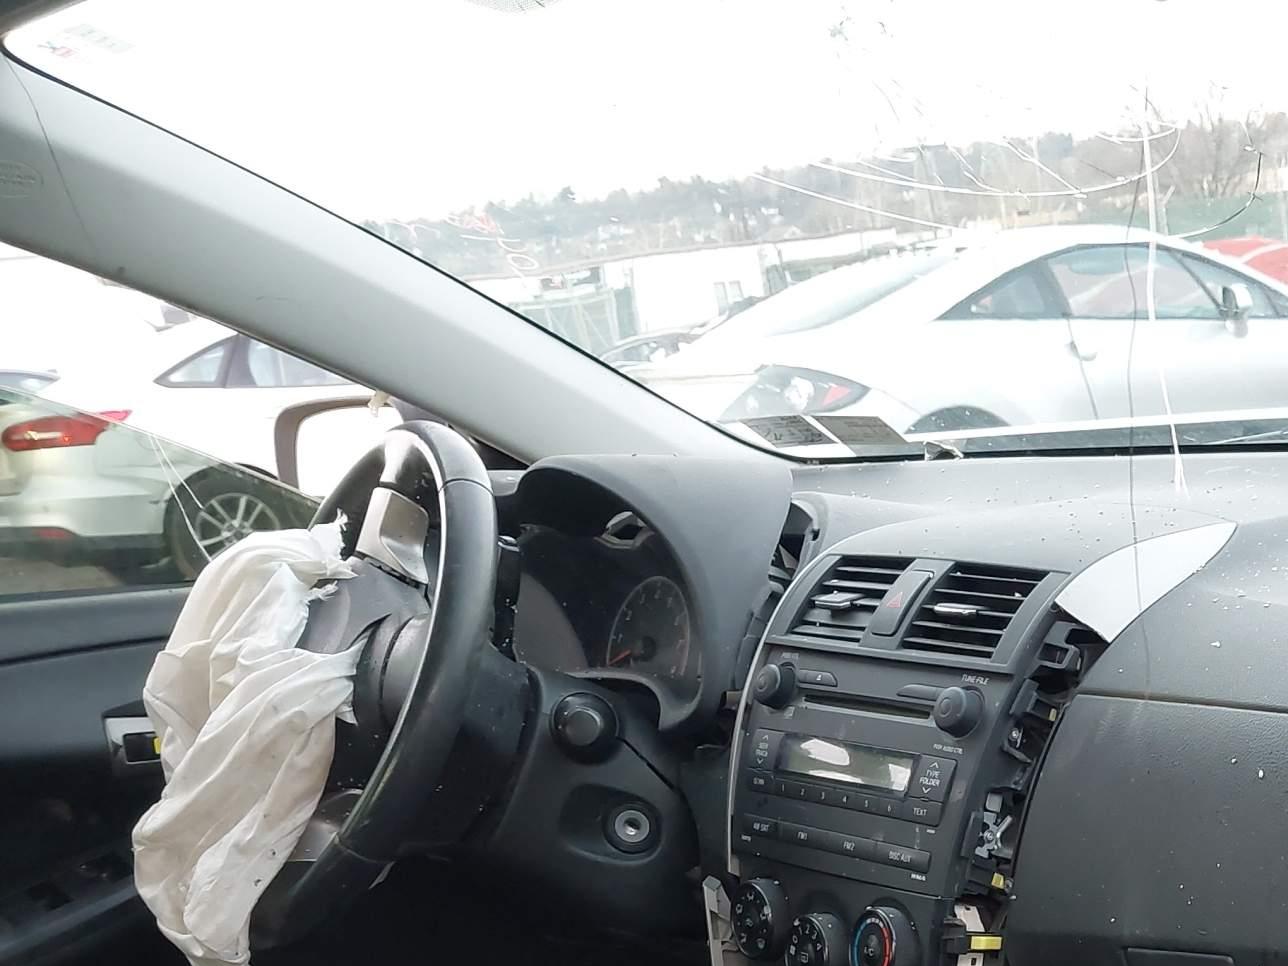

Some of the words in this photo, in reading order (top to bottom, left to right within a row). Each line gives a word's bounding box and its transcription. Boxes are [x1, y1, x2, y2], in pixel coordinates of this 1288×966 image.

[926, 769, 941, 778] TYPE
[919, 776, 941, 786] FOLDER
[913, 807, 928, 816] TEXT
